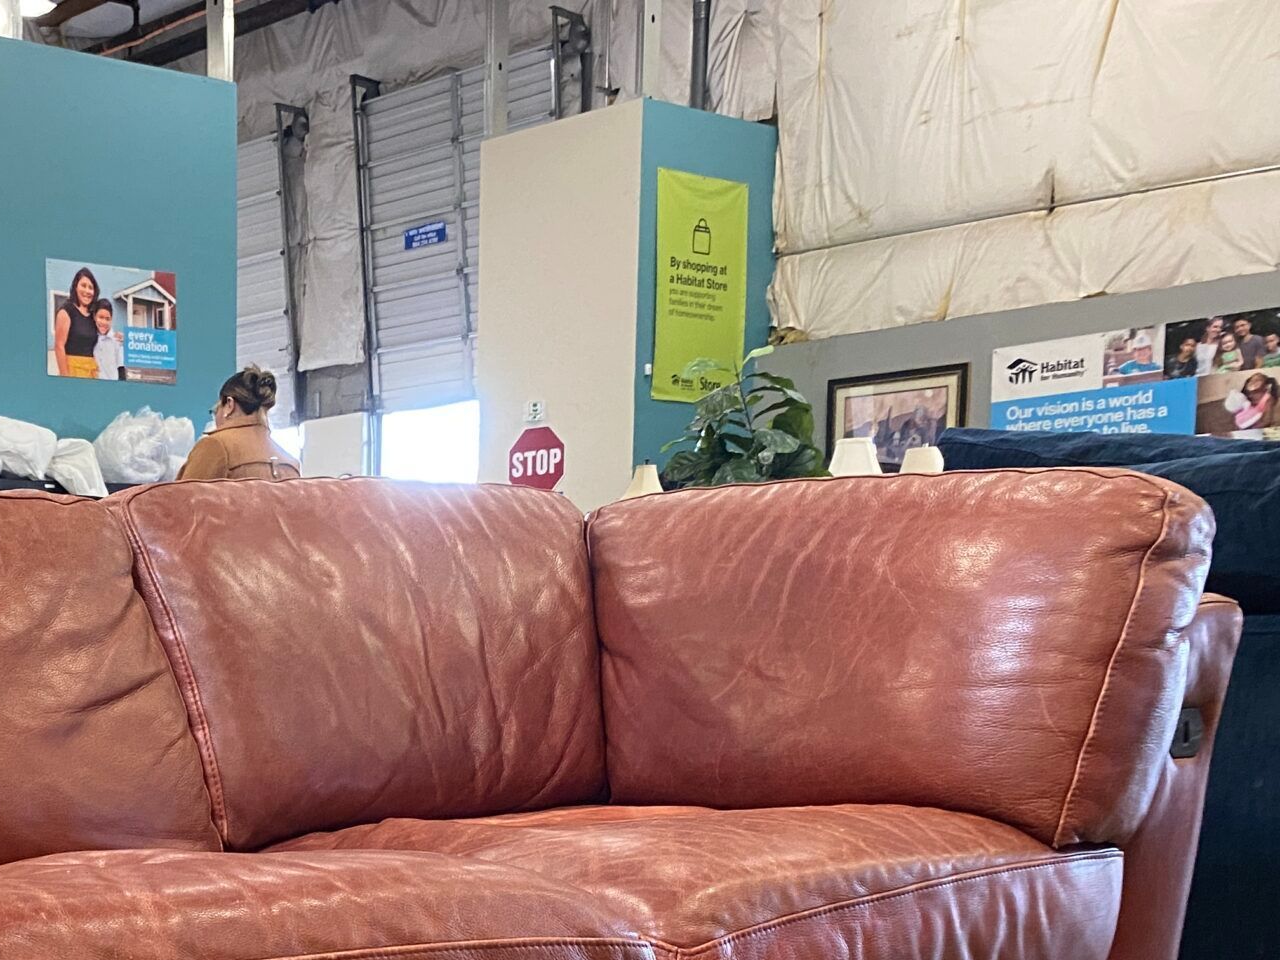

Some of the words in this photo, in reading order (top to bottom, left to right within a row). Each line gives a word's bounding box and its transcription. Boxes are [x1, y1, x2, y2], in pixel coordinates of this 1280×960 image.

[670, 256, 681, 270] By
[682, 259, 718, 276] shopping
[719, 265, 727, 276] at
[669, 275, 674, 283] a
[676, 273, 705, 288] Habitat
[706, 278, 728, 291] Store
[128, 331, 154, 342] every
[128, 341, 168, 352] donation
[1040, 357, 1085, 374] Habitat
[1040, 374, 1051, 382] for
[1005, 406, 1032, 421] Our
[1036, 401, 1079, 417] vision
[1081, 398, 1094, 412] is
[1096, 398, 1107, 409] a
[1108, 389, 1153, 407] world
[1054, 410, 1124, 429] everyone
[1127, 405, 1155, 420] has
[1157, 406, 1168, 417] a
[511, 447, 562, 478] STOP
